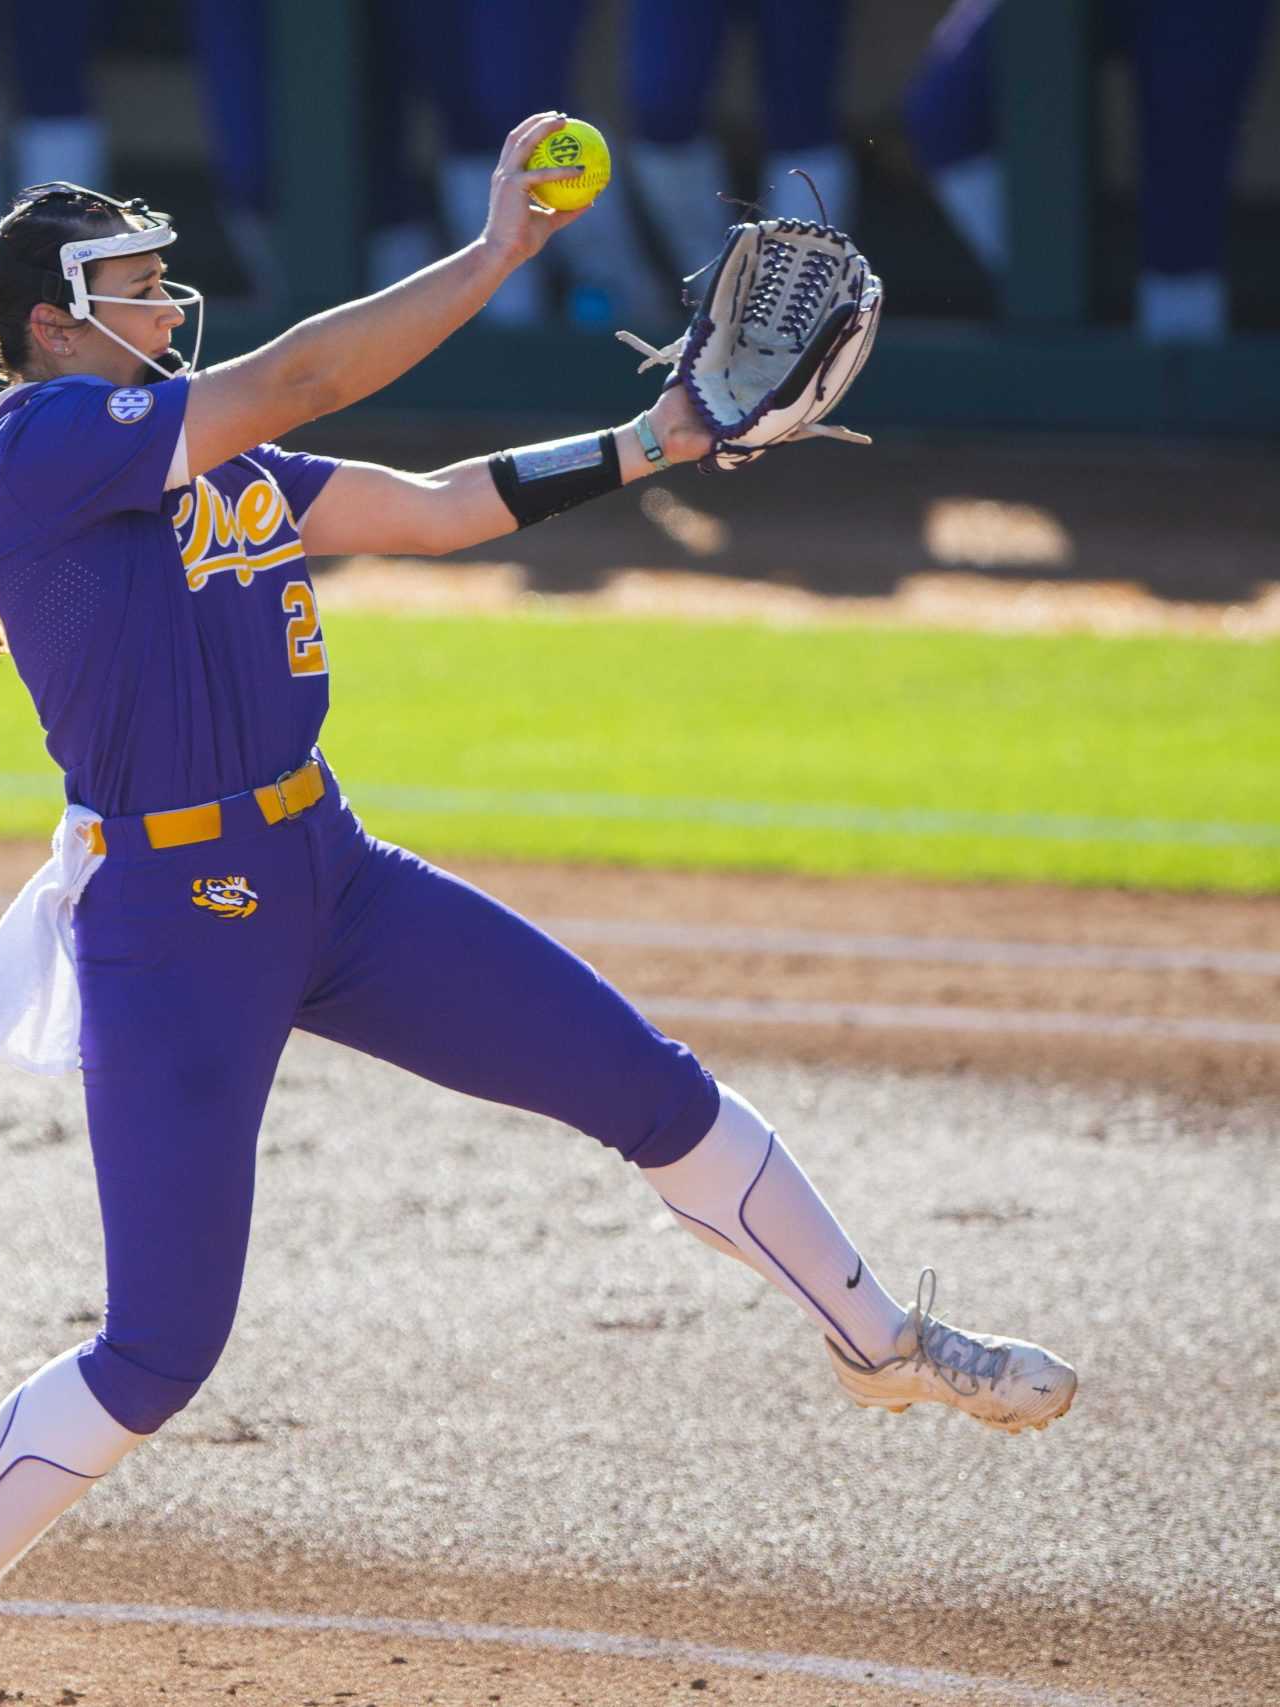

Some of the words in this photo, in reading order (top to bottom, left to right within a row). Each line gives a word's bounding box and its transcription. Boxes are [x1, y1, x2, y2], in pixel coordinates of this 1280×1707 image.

[549, 134, 579, 164] SEC
[72, 250, 92, 260] LSU
[67, 266, 78, 277] 27
[110, 389, 151, 420] SEC
